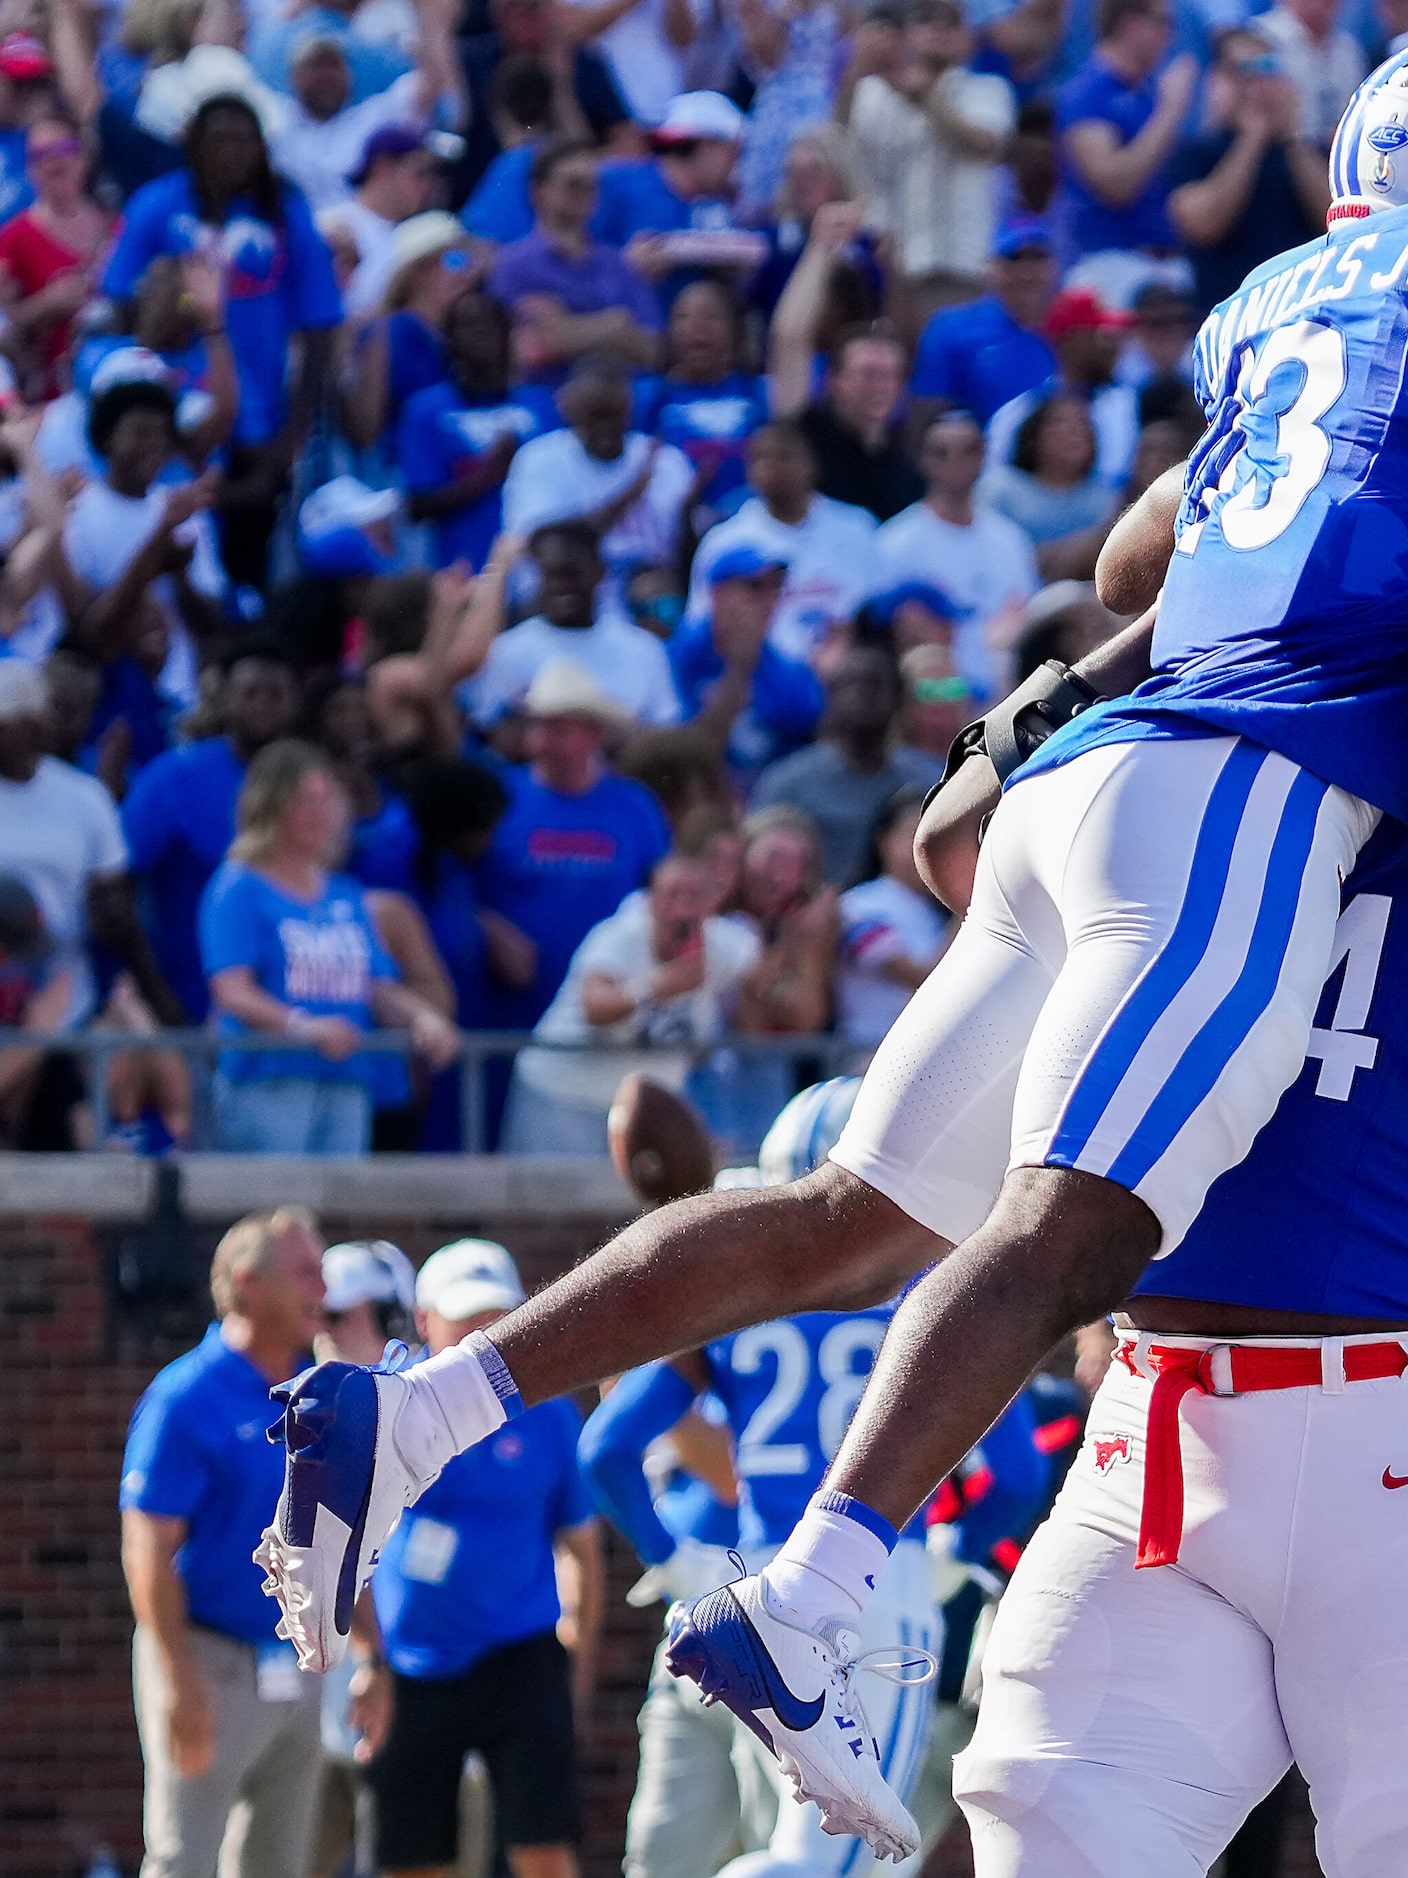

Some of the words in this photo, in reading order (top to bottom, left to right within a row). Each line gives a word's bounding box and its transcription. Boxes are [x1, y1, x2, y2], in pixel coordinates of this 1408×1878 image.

[1371, 127, 1404, 142] ACC
[1199, 232, 1380, 402] DANIELS
[730, 1319, 888, 1476] 28
